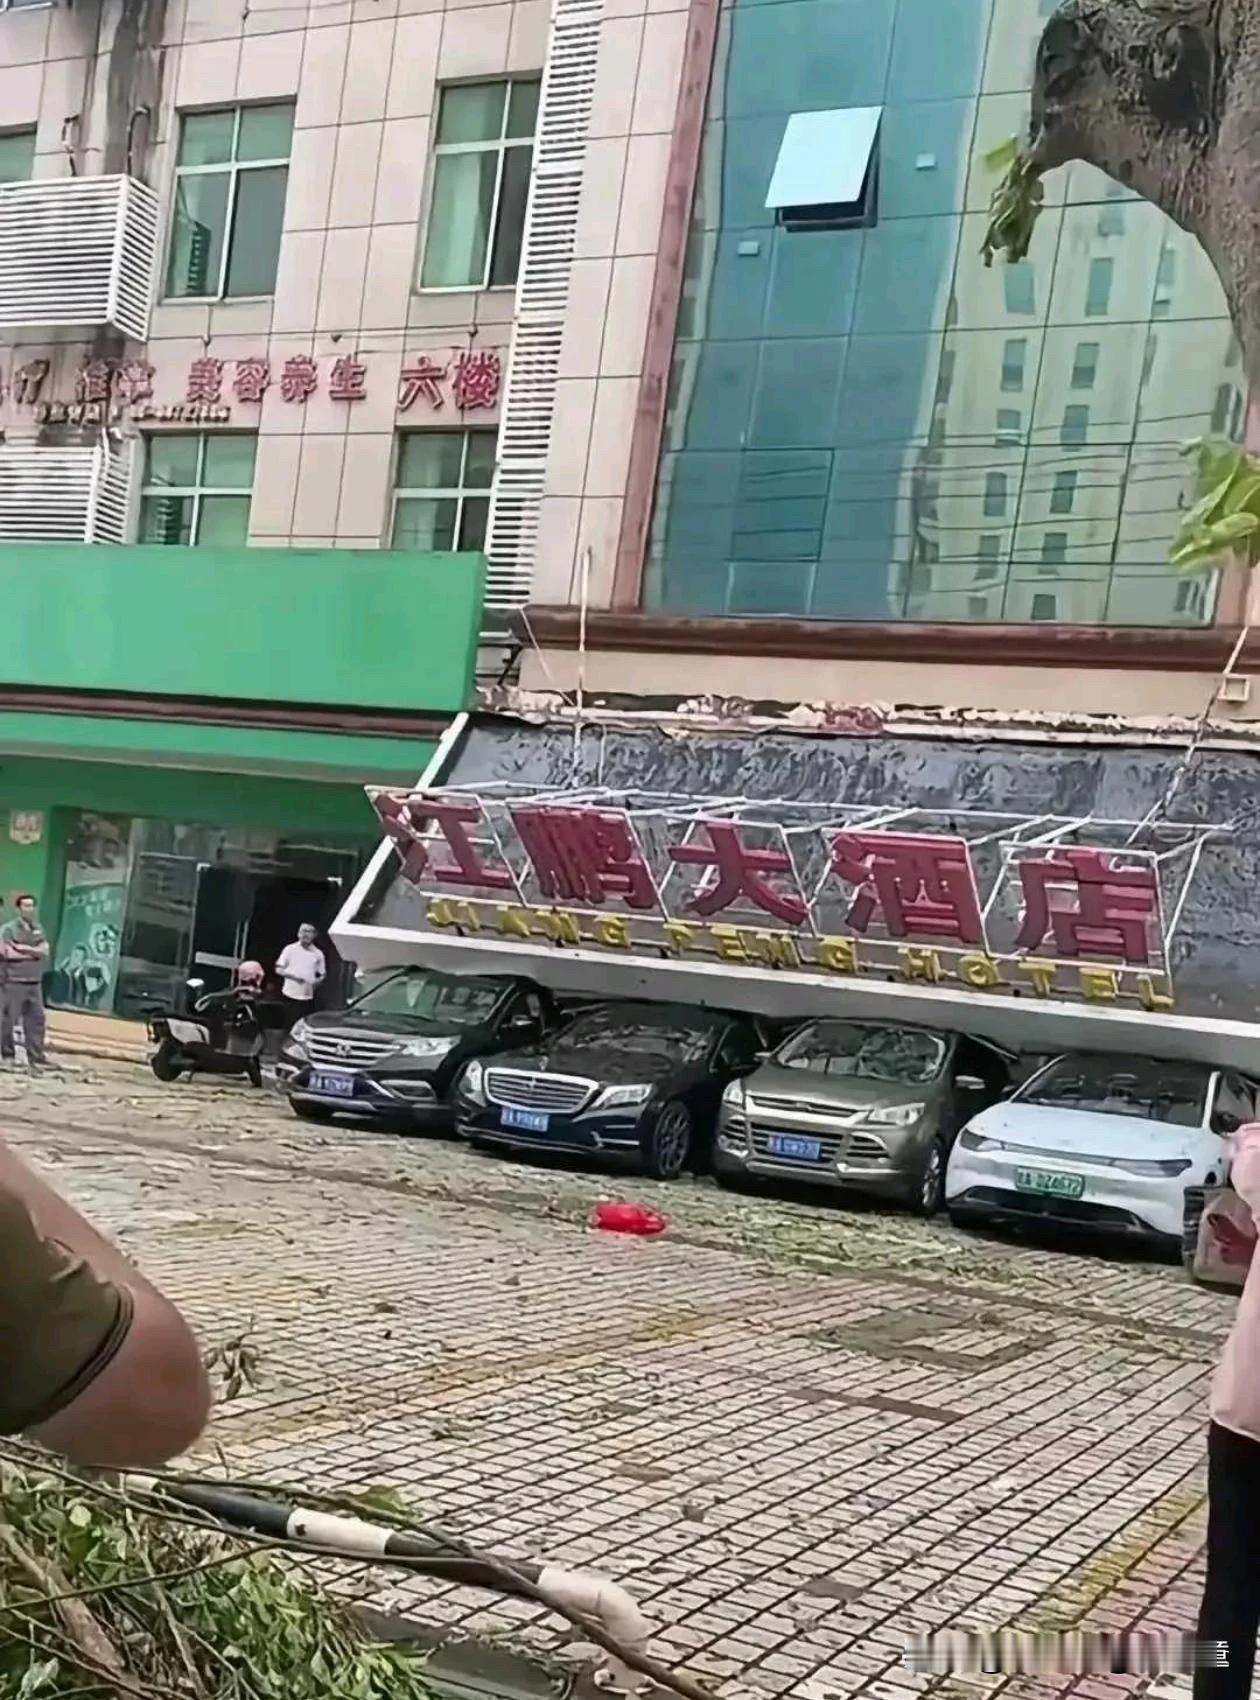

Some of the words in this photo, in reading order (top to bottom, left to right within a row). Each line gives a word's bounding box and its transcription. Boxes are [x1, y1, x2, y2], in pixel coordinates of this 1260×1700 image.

[186, 354, 368, 404] 美容养生
[397, 353, 500, 413] 六楼
[426, 897, 632, 951] JIANG
[663, 921, 859, 976] PENG
[898, 944, 1175, 1011] HOTEL
